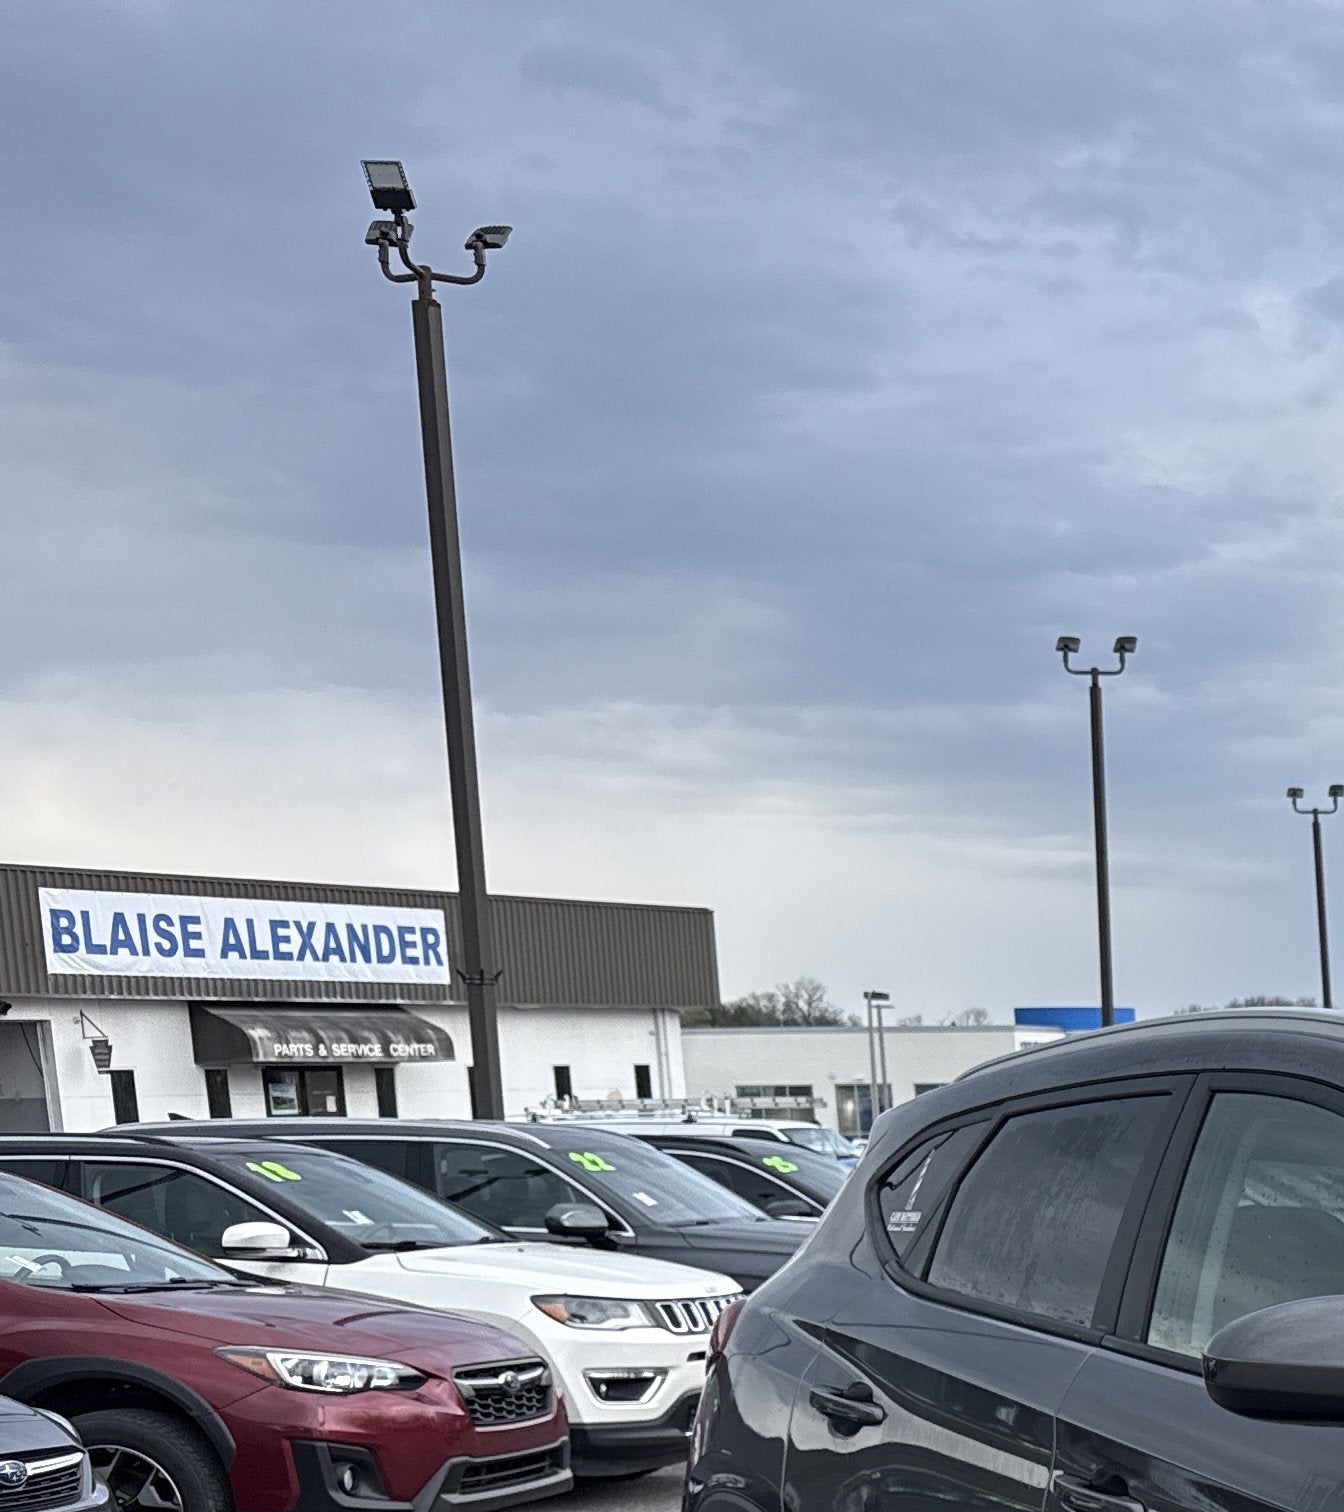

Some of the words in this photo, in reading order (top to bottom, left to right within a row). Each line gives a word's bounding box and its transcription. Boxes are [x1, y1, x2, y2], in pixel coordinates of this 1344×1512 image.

[49, 908, 206, 958] BLAISE
[220, 917, 444, 966] ALEXANDER
[273, 1043, 314, 1057] PARTS
[318, 1044, 327, 1057] &
[331, 1043, 384, 1057] SERVICE
[389, 1043, 436, 1057] CENTER
[245, 1160, 303, 1183] 18
[568, 1151, 617, 1172] 22
